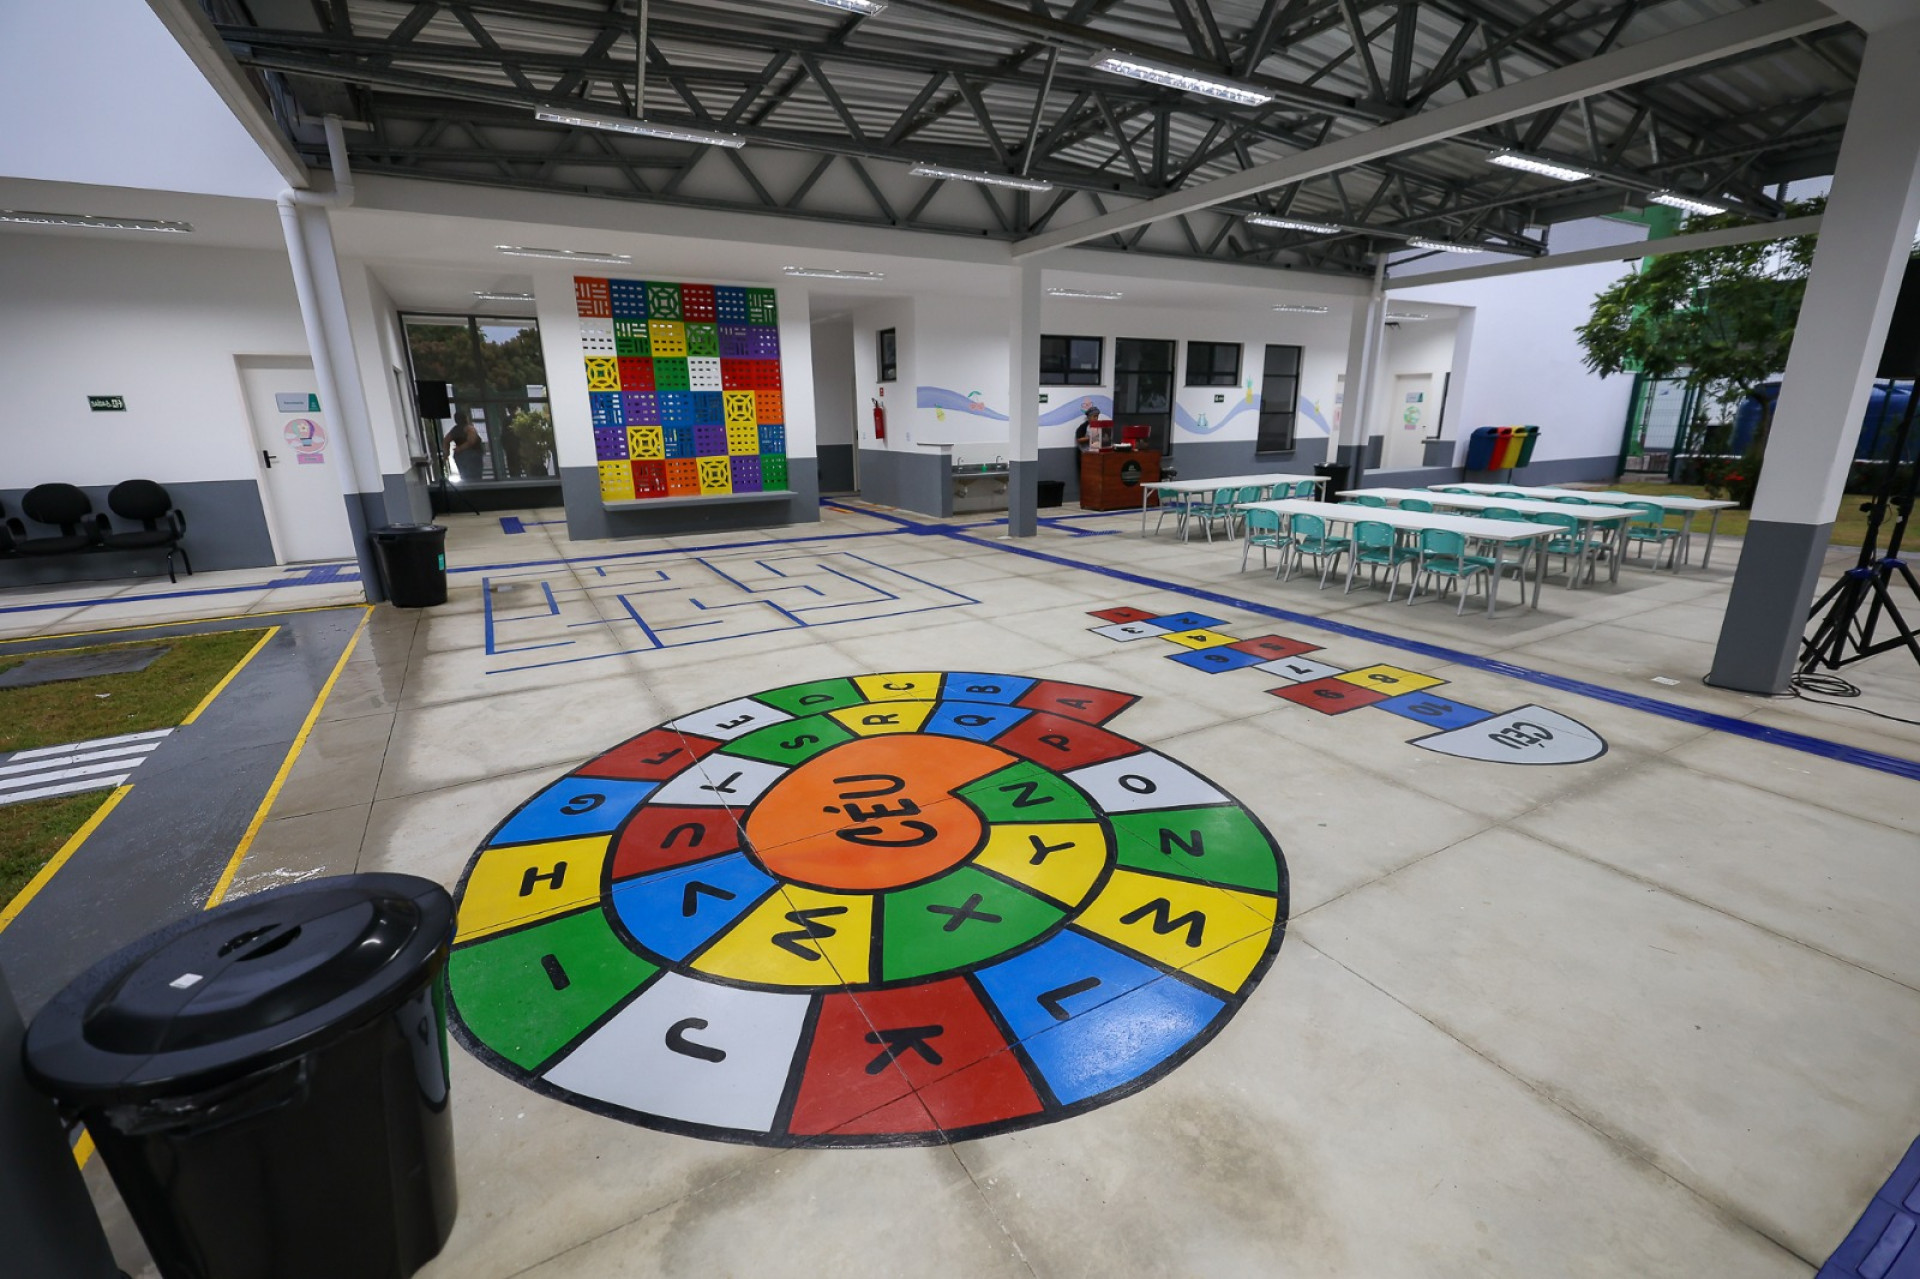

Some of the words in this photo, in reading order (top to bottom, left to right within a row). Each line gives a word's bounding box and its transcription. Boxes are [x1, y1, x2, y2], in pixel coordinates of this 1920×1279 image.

[1120, 626, 1144, 635] 3
[1175, 617, 1198, 626] 2
[1186, 633, 1207, 643] 4
[1258, 642, 1285, 651] 5
[1203, 653, 1230, 664] 6
[1285, 663, 1313, 675] 7
[885, 682, 916, 691] C
[1367, 673, 1400, 684] 8
[966, 685, 1002, 695] B
[1313, 688, 1345, 701] 9
[799, 694, 836, 706] D
[1055, 696, 1093, 711] A
[1406, 701, 1454, 717] 10
[715, 714, 756, 731] E
[862, 713, 900, 726] R
[953, 714, 997, 727] Q
[780, 734, 820, 752] S
[1037, 733, 1071, 752] P
[1488, 721, 1555, 750] CÉU
[640, 748, 683, 766] F
[699, 771, 744, 794] T
[1118, 774, 1157, 795] O
[560, 794, 606, 816] G
[823, 774, 939, 848] CÉU
[661, 822, 706, 850] U
[1158, 828, 1205, 858] N
[1029, 835, 1076, 866] Y
[519, 861, 568, 897] H
[682, 881, 737, 918] V
[926, 894, 1003, 933] X
[1119, 898, 1207, 949] M
[771, 906, 849, 962] W
[541, 953, 571, 991] I
[1037, 977, 1102, 1022] L
[664, 1018, 727, 1064] J
[865, 1025, 945, 1075] K
